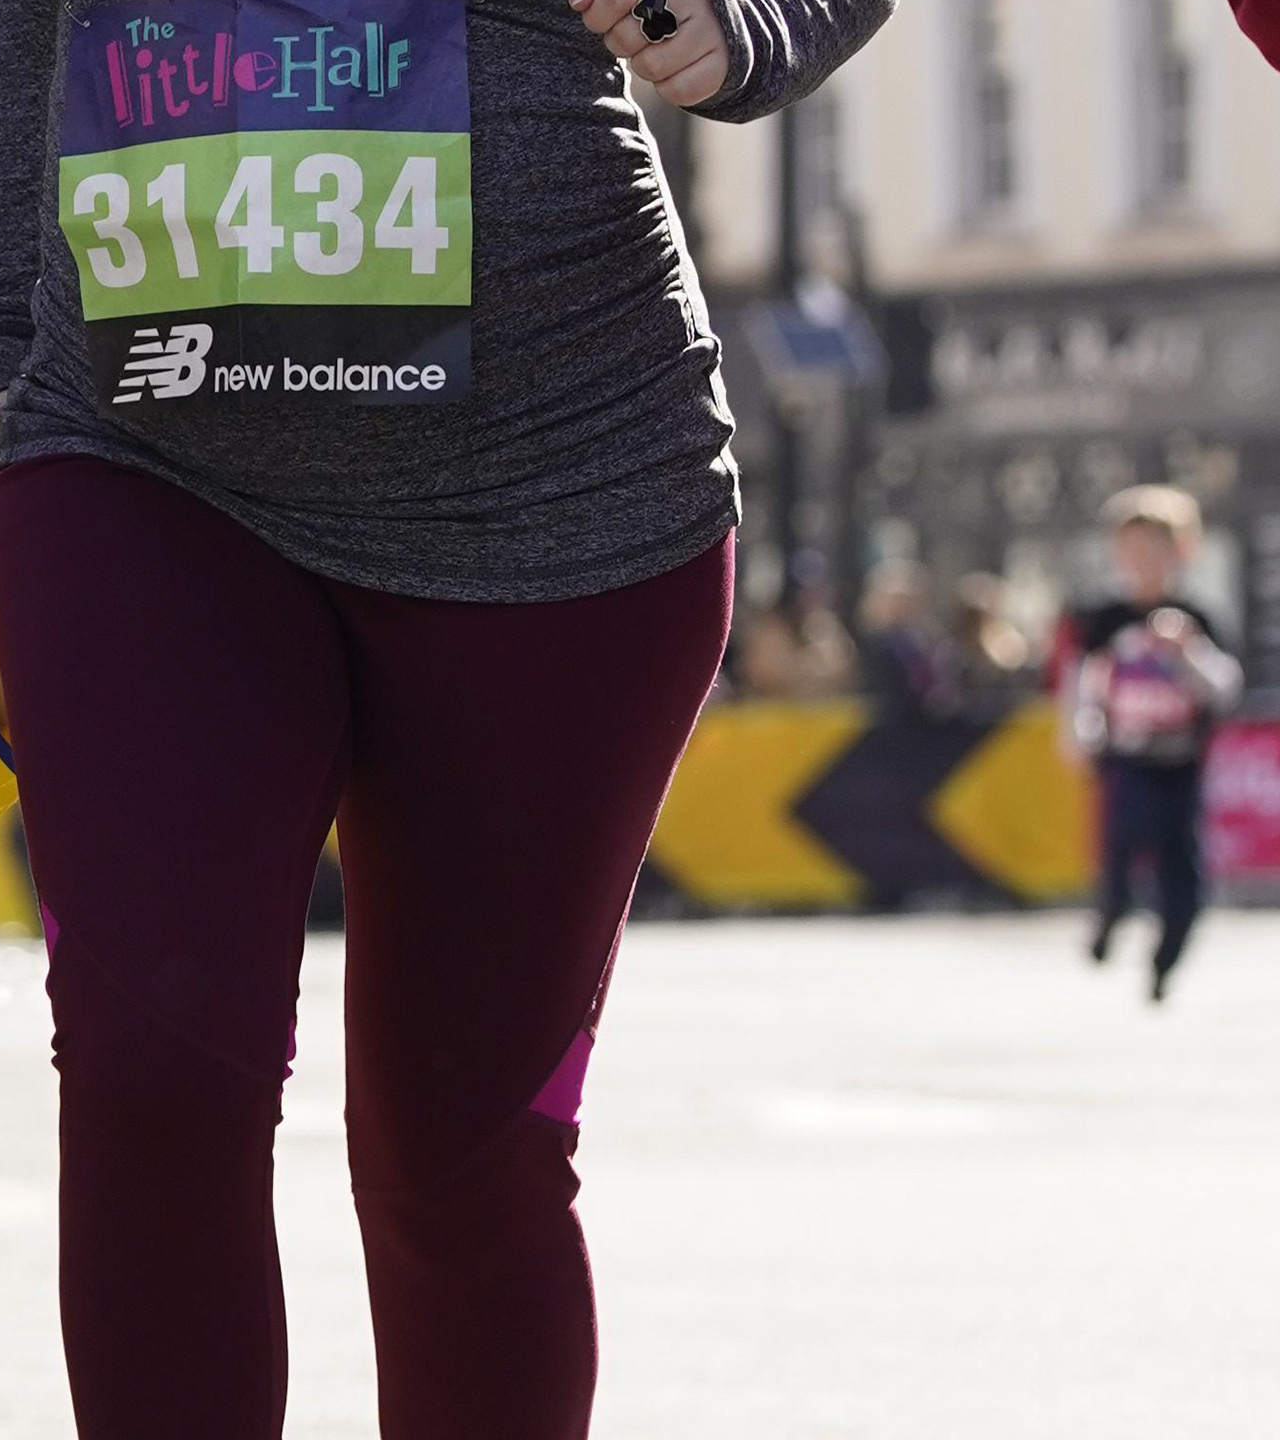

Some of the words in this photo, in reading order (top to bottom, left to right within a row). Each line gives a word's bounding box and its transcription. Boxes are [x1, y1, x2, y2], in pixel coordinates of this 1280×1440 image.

[126, 17, 175, 47] The
[106, 32, 278, 129] little
[73, 152, 449, 288] 31434
[214, 364, 274, 393] new
[284, 358, 446, 392] balance
